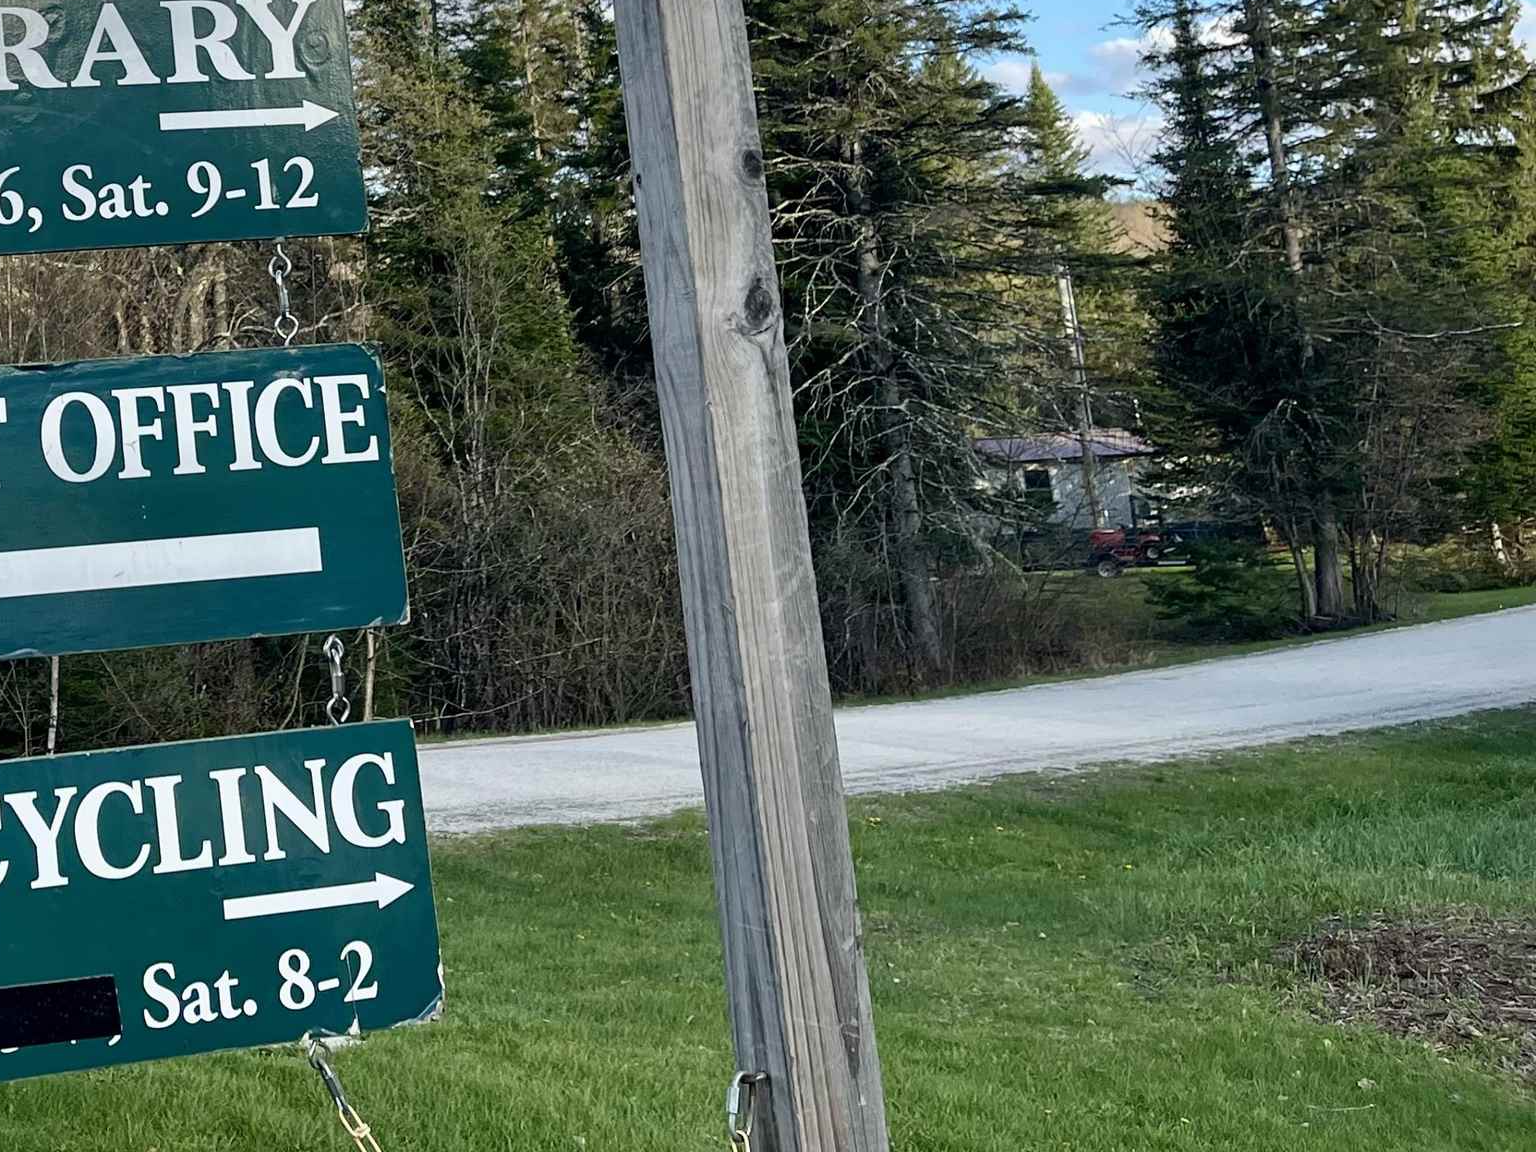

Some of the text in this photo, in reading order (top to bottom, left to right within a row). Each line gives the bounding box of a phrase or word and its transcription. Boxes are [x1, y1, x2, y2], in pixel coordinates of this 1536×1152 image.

[61, 163, 170, 223] Sat.
[185, 154, 320, 216] 9-12
[40, 372, 380, 484] OFFICE
[142, 961, 257, 1030] Sat.
[277, 940, 379, 1013] 8-2
